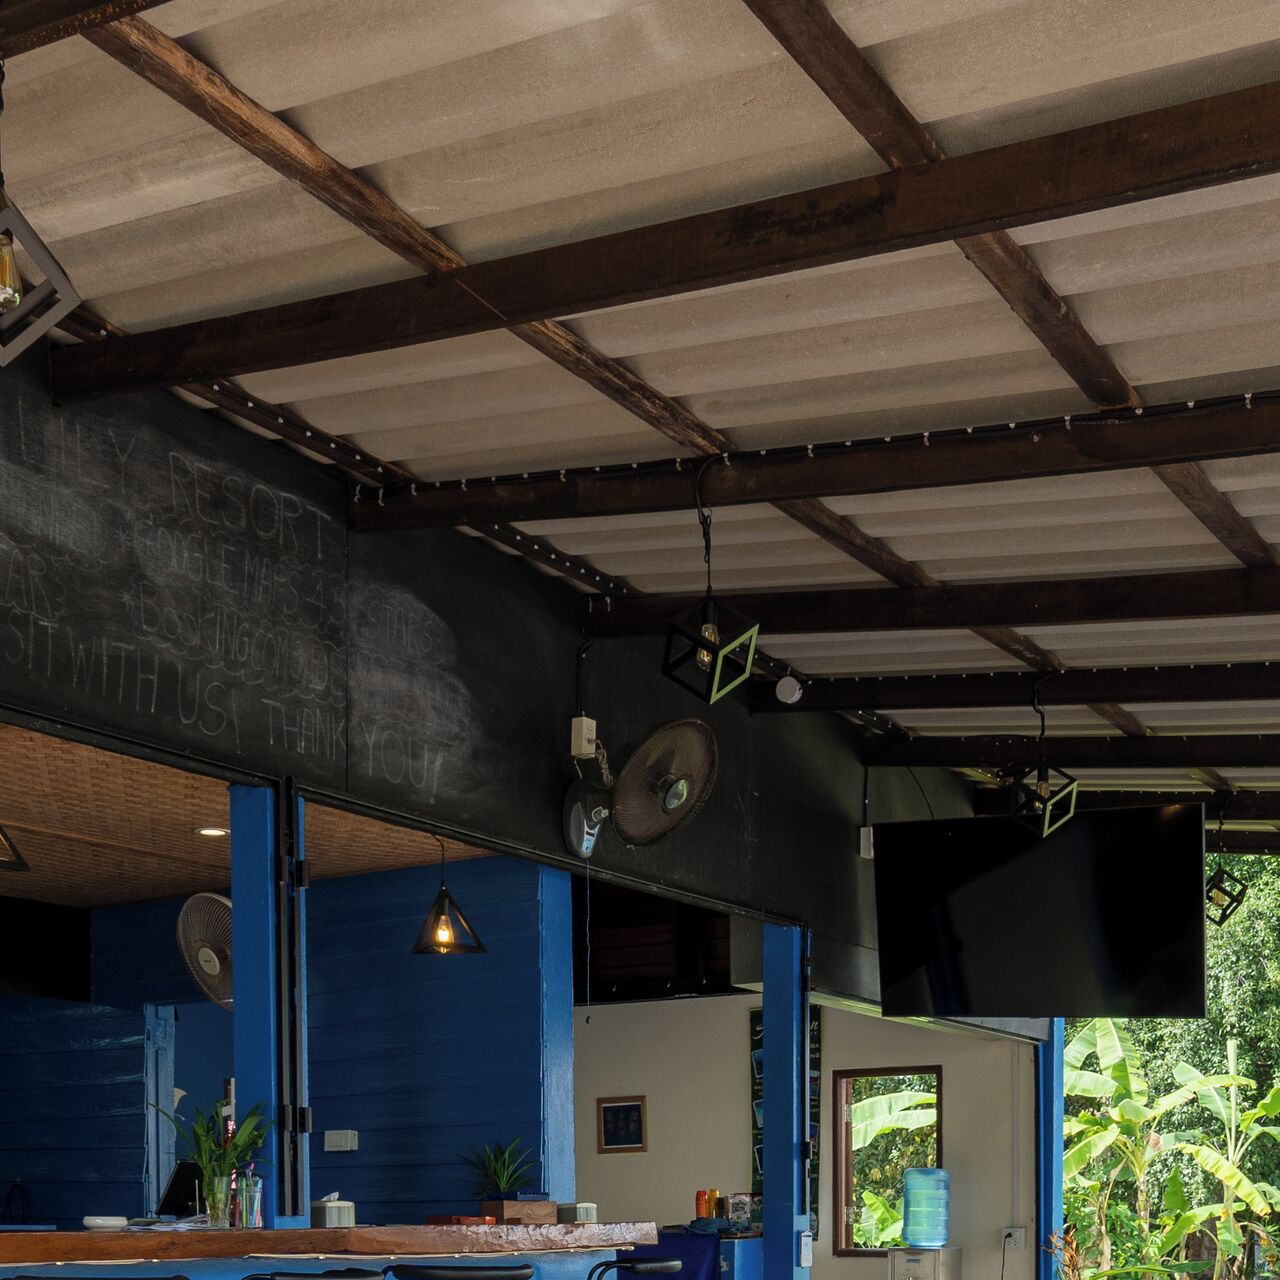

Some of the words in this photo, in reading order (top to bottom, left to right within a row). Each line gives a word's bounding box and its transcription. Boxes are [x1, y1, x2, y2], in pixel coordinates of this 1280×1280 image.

[17, 398, 136, 496] LILY
[168, 451, 332, 561] RESORT
[243, 549, 299, 615] MAPS
[66, 626, 160, 713] WITH
[261, 698, 347, 762] THANK
